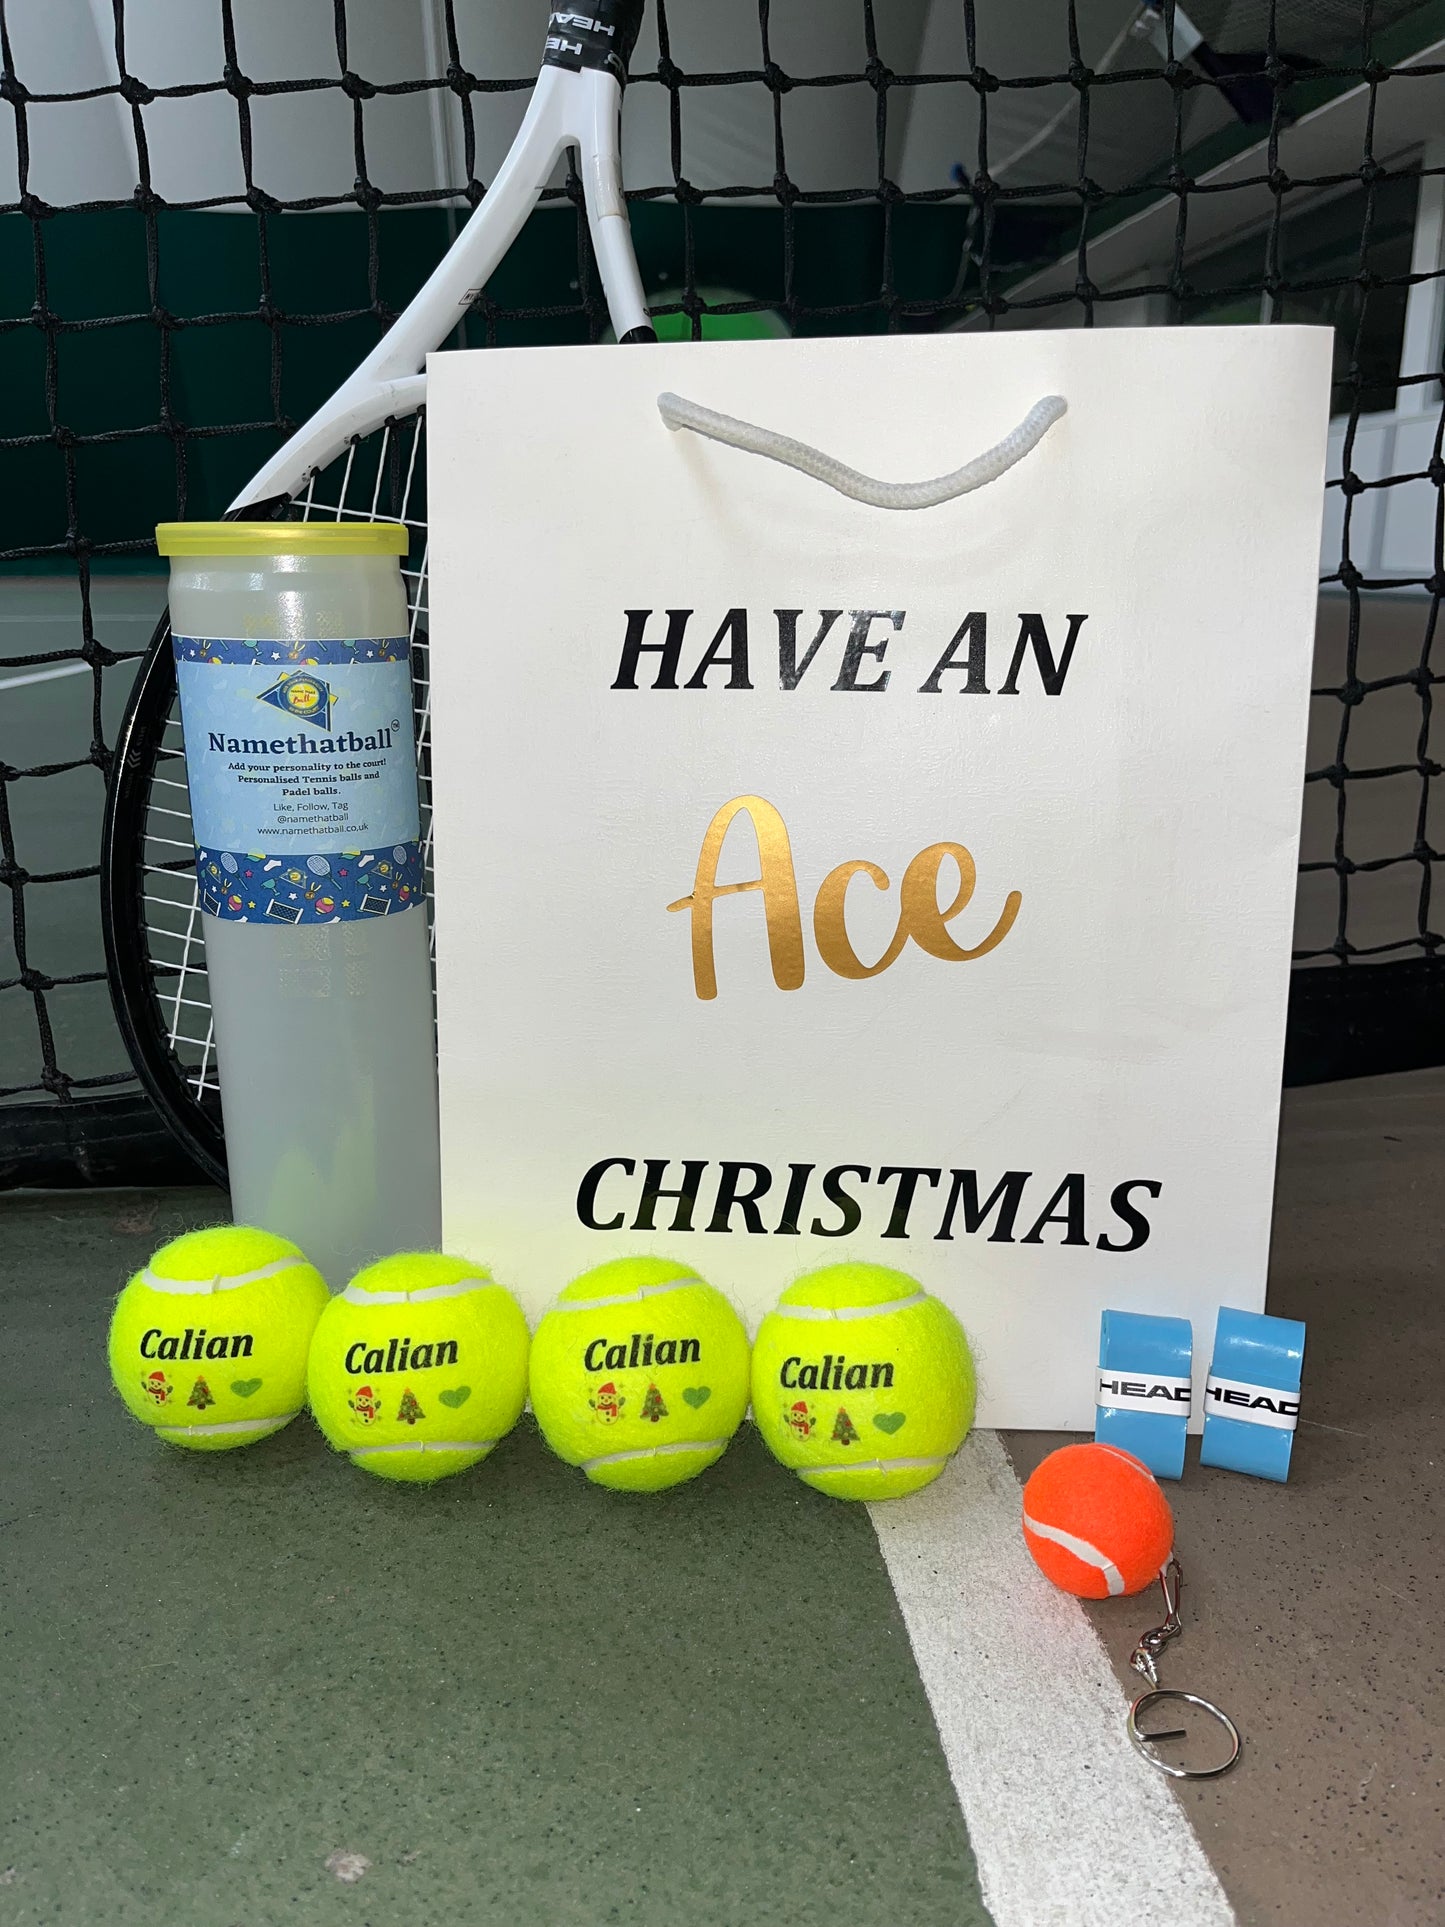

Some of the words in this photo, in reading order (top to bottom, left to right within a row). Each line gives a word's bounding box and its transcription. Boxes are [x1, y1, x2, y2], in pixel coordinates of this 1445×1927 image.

[610, 608, 906, 693] HAVE
[918, 611, 1089, 696] AN
[208, 728, 392, 755] Namethatball
[228, 762, 246, 771] Add
[247, 765, 271, 773] your
[273, 762, 331, 773] personality
[346, 761, 361, 769] the
[363, 758, 387, 768] court!
[237, 774, 300, 784] Personalised
[302, 775, 338, 783] Tennis
[339, 773, 362, 782] balls
[364, 771, 380, 780] and
[282, 787, 311, 796] Padel
[313, 787, 342, 796] balls.
[273, 803, 295, 812] Like,
[297, 802, 330, 812] Follow,
[332, 801, 349, 811] Tag
[277, 812, 349, 824] @namethatball
[257, 822, 369, 835] www.namethatball.co.uk
[666, 794, 1023, 1000] Ace
[575, 1157, 1163, 1253] CHRISTMAS
[140, 1328, 254, 1360] Calian
[344, 1338, 459, 1375] Calian
[584, 1333, 701, 1372] Calian
[779, 1354, 895, 1391] Calian
